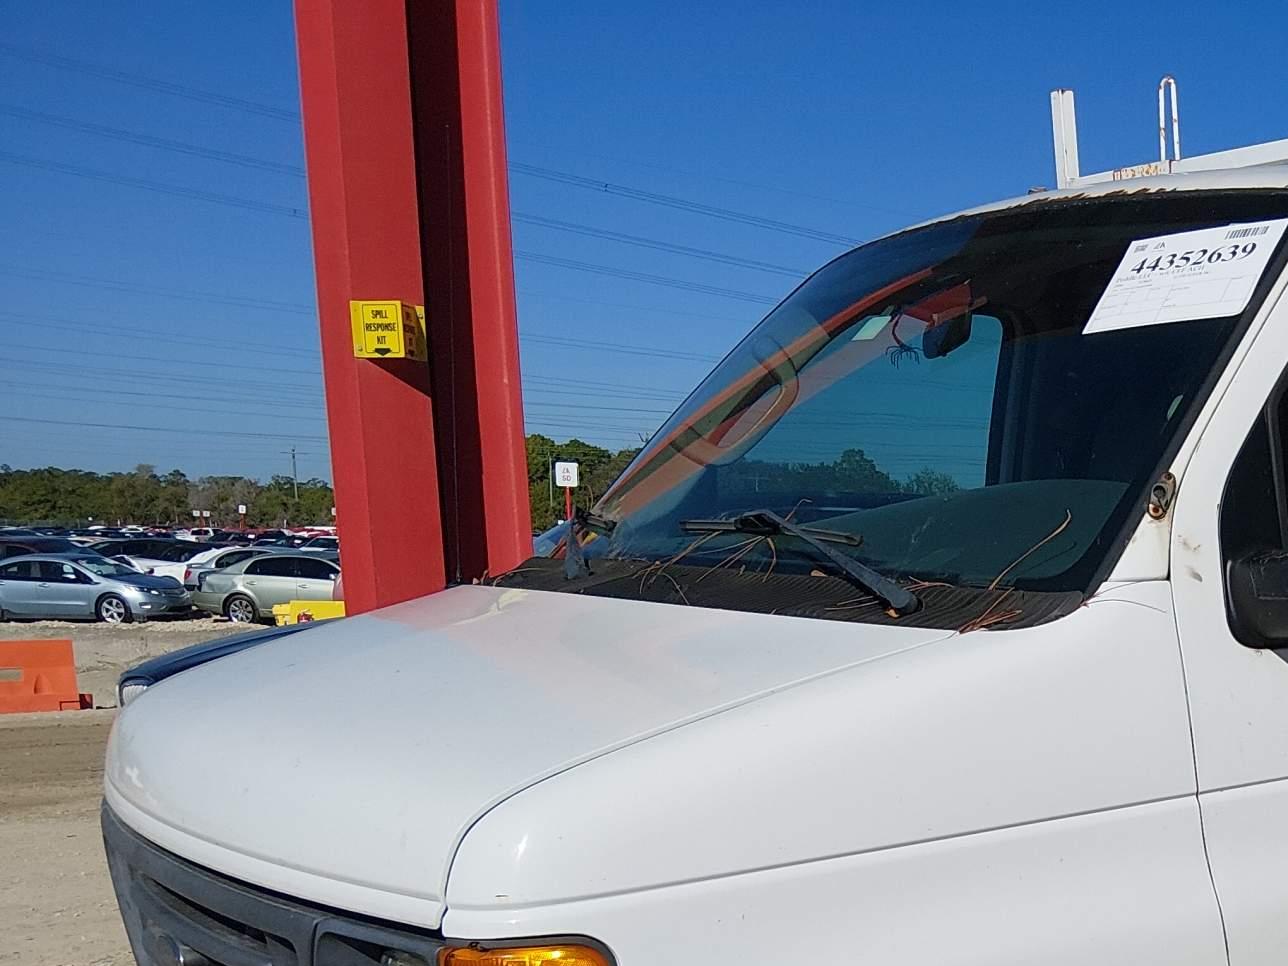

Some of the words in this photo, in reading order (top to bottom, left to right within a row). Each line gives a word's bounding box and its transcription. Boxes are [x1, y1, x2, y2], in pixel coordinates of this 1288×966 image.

[1131, 242, 1257, 274] 44352639
[371, 310, 388, 319] SPILL
[365, 323, 397, 332] RESPONSE
[376, 335, 387, 345] KIT
